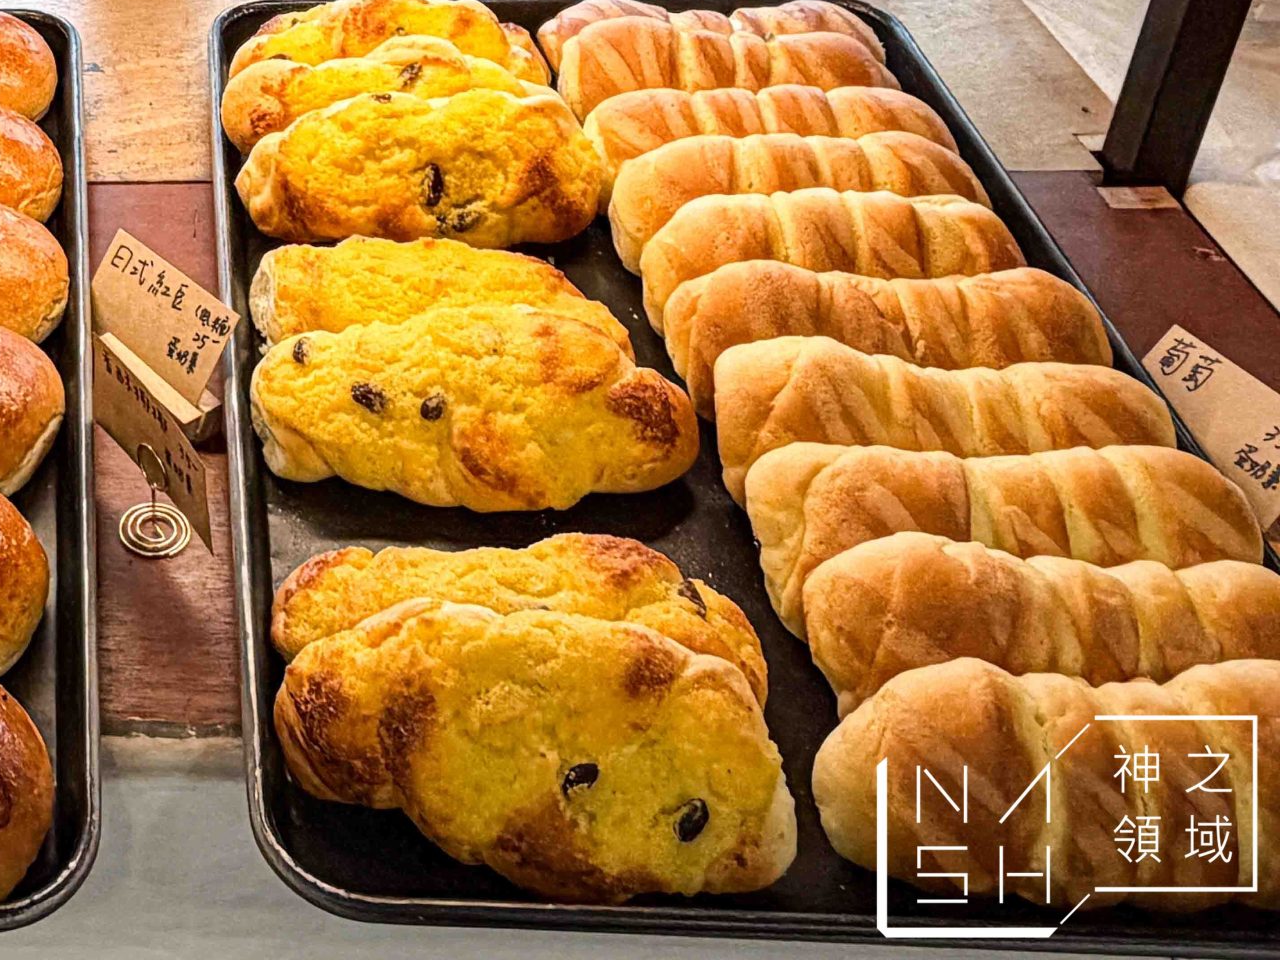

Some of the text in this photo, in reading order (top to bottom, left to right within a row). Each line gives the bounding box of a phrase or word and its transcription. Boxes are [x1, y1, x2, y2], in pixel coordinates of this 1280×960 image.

[110, 244, 189, 311] 日式紅豆
[1158, 338, 1223, 392] 葡萄
